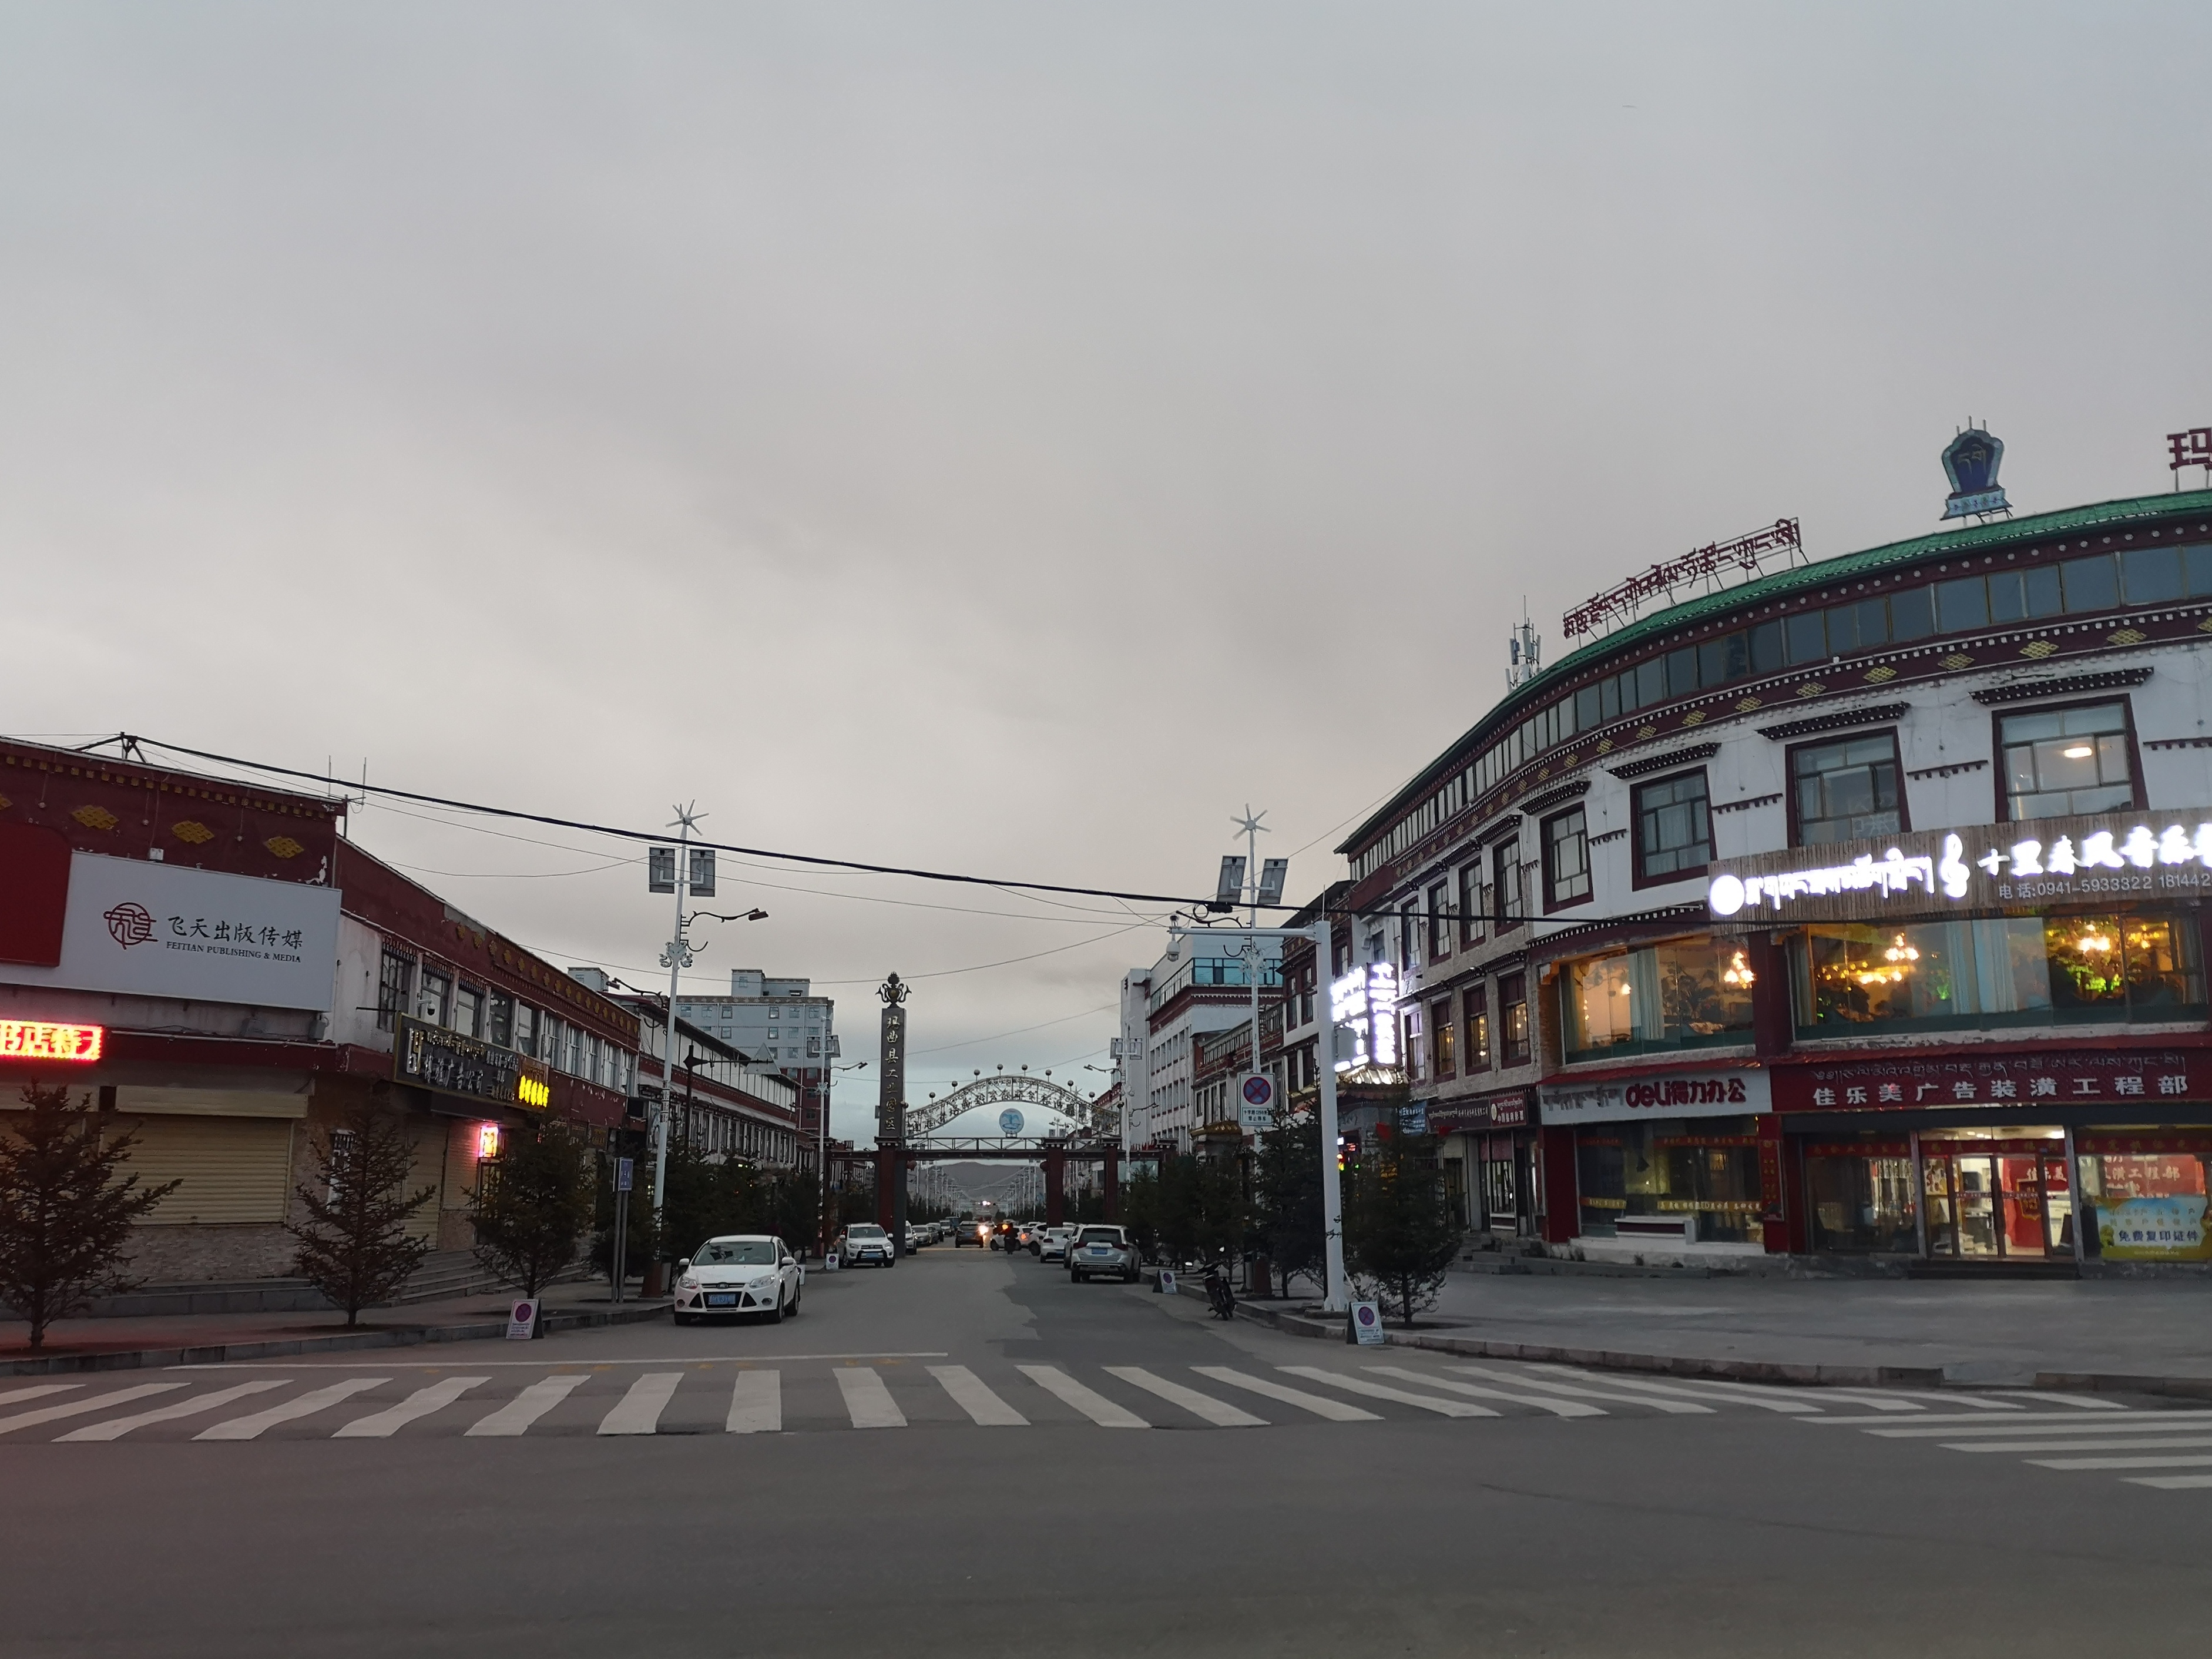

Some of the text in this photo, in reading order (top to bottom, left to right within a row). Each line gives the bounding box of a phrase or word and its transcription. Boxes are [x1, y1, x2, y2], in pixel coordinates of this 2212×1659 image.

[2166, 428, 2212, 471] 玛
[168, 916, 304, 950] 飞天出版传媒
[166, 941, 204, 953] FEITIAN
[206, 946, 262, 959] PUBLISHING
[272, 953, 301, 963] MEDIA
[1813, 1075, 2188, 1105] 佳乐美广告装潢工程部
